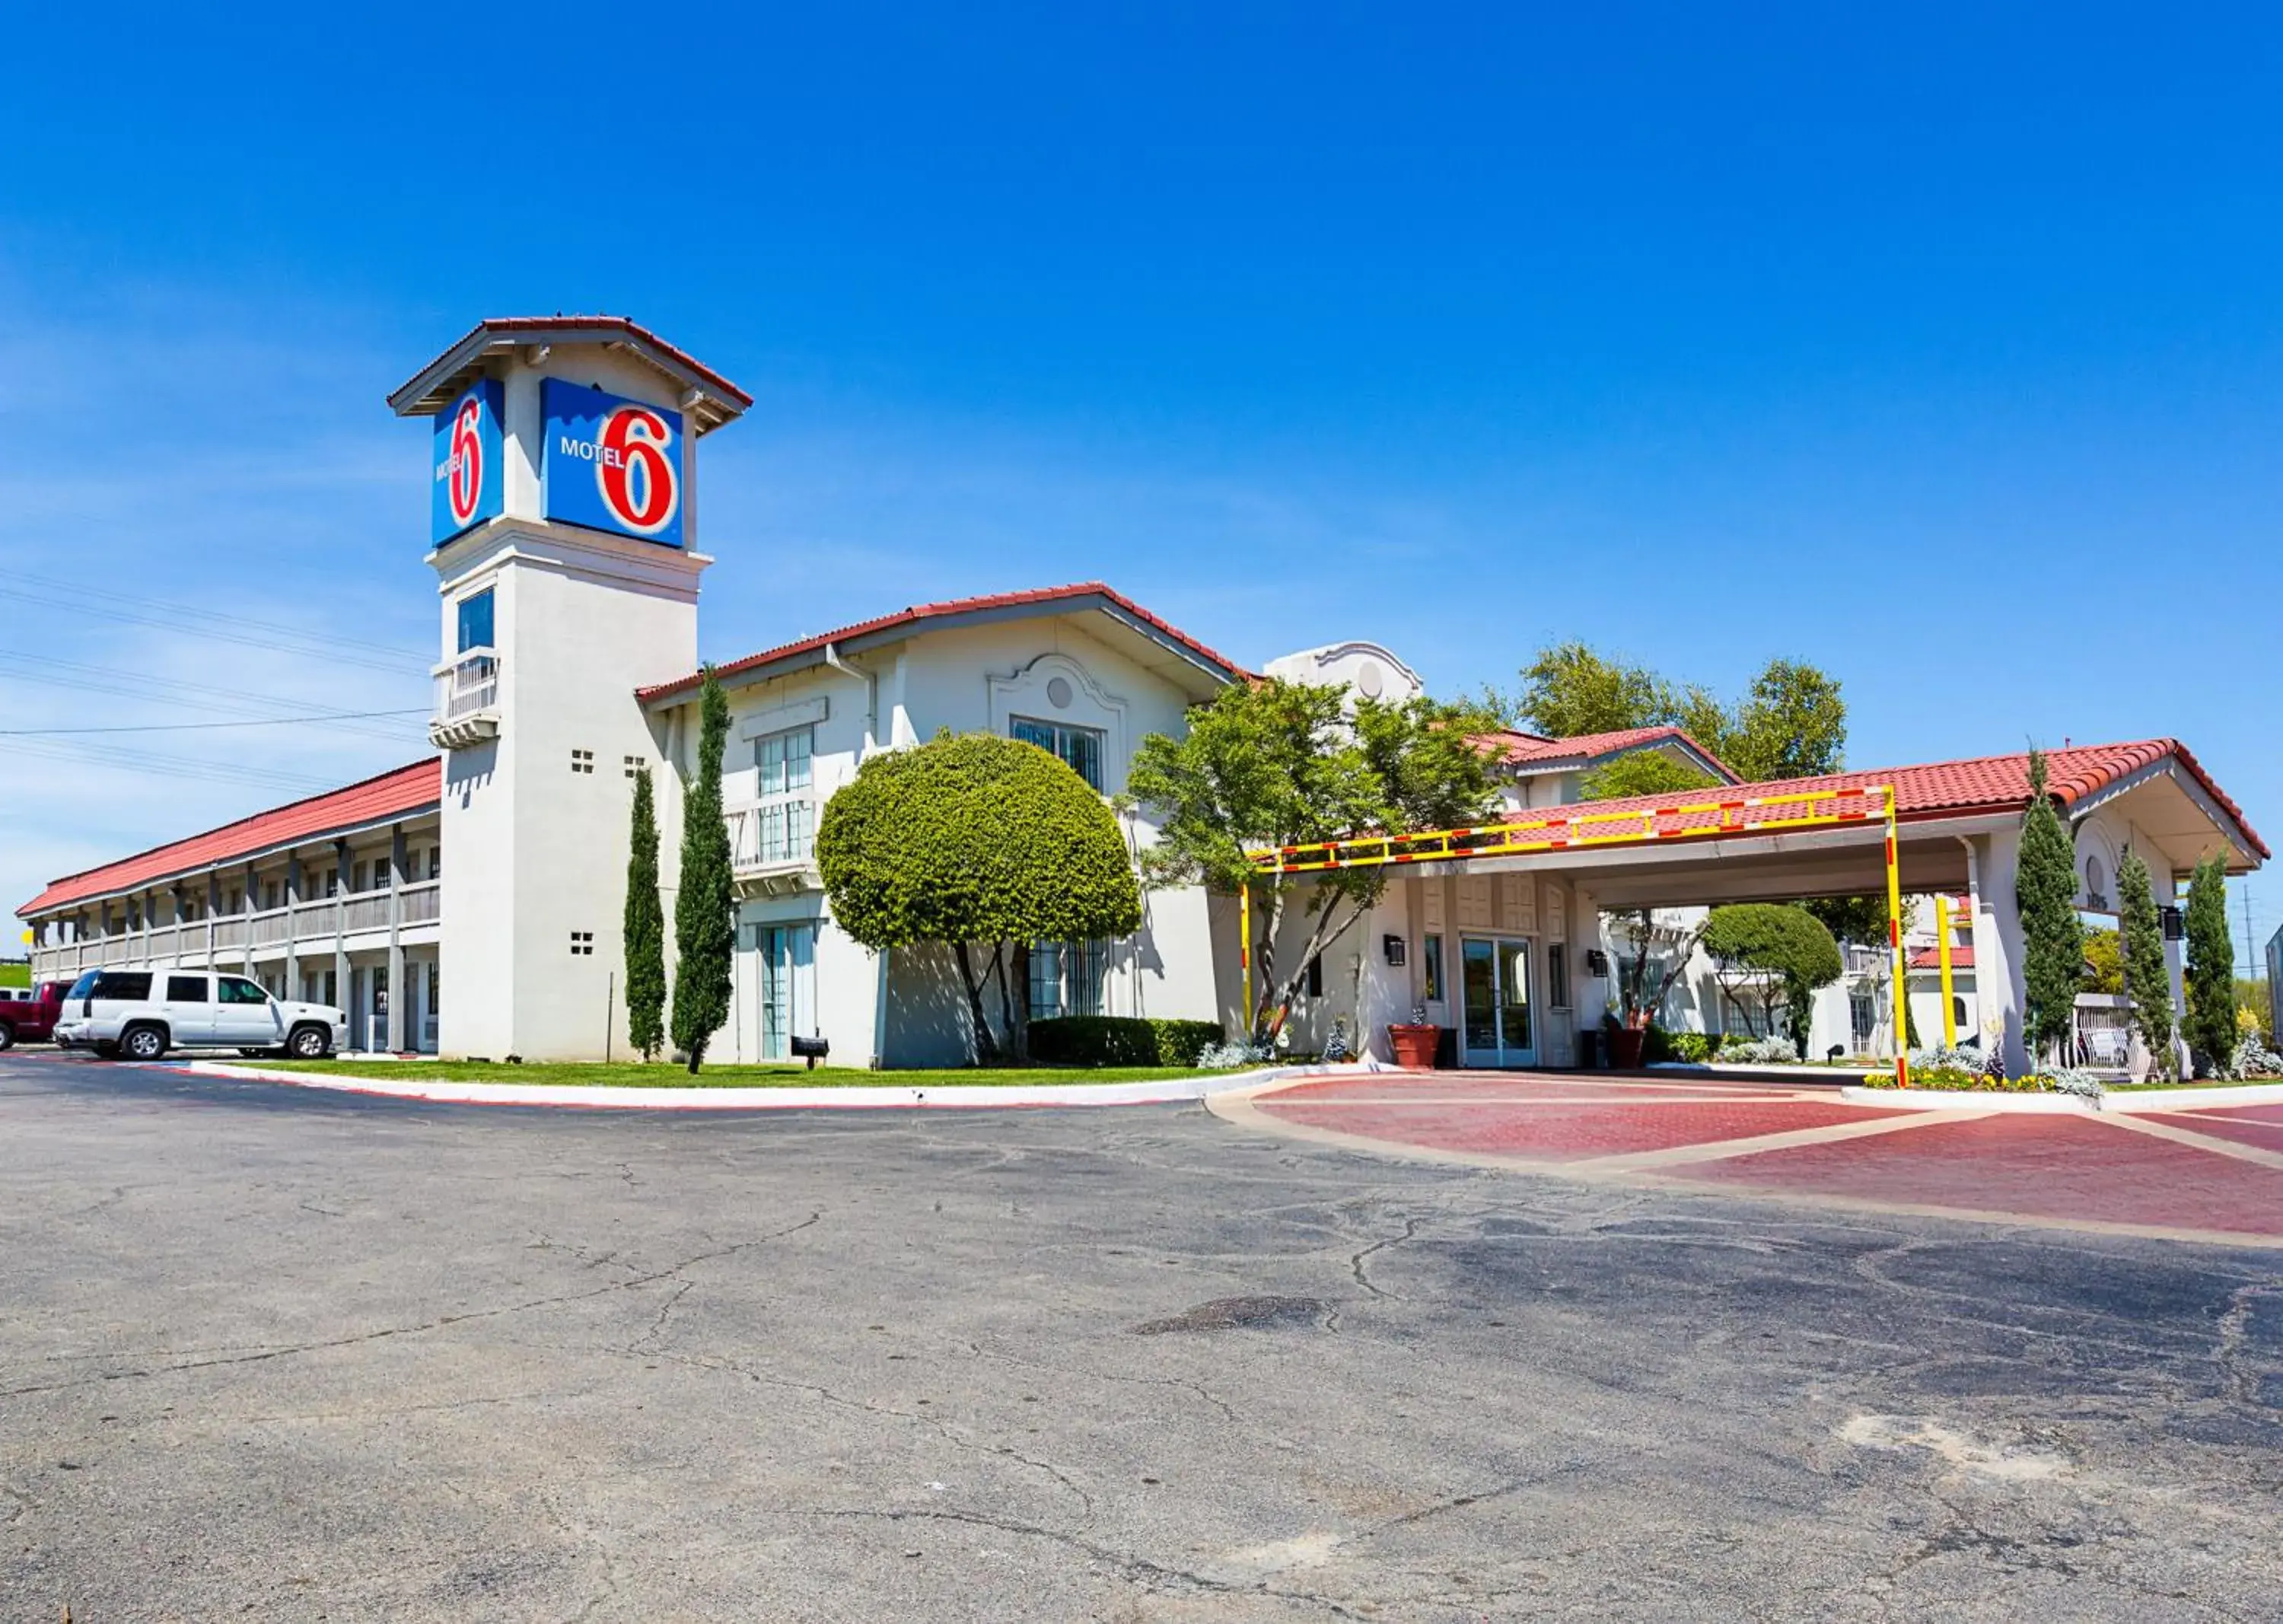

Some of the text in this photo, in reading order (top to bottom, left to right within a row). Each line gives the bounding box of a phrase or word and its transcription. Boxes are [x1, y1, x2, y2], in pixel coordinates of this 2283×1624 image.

[450, 393, 482, 526] 6
[561, 407, 676, 532] MOTEL 6
